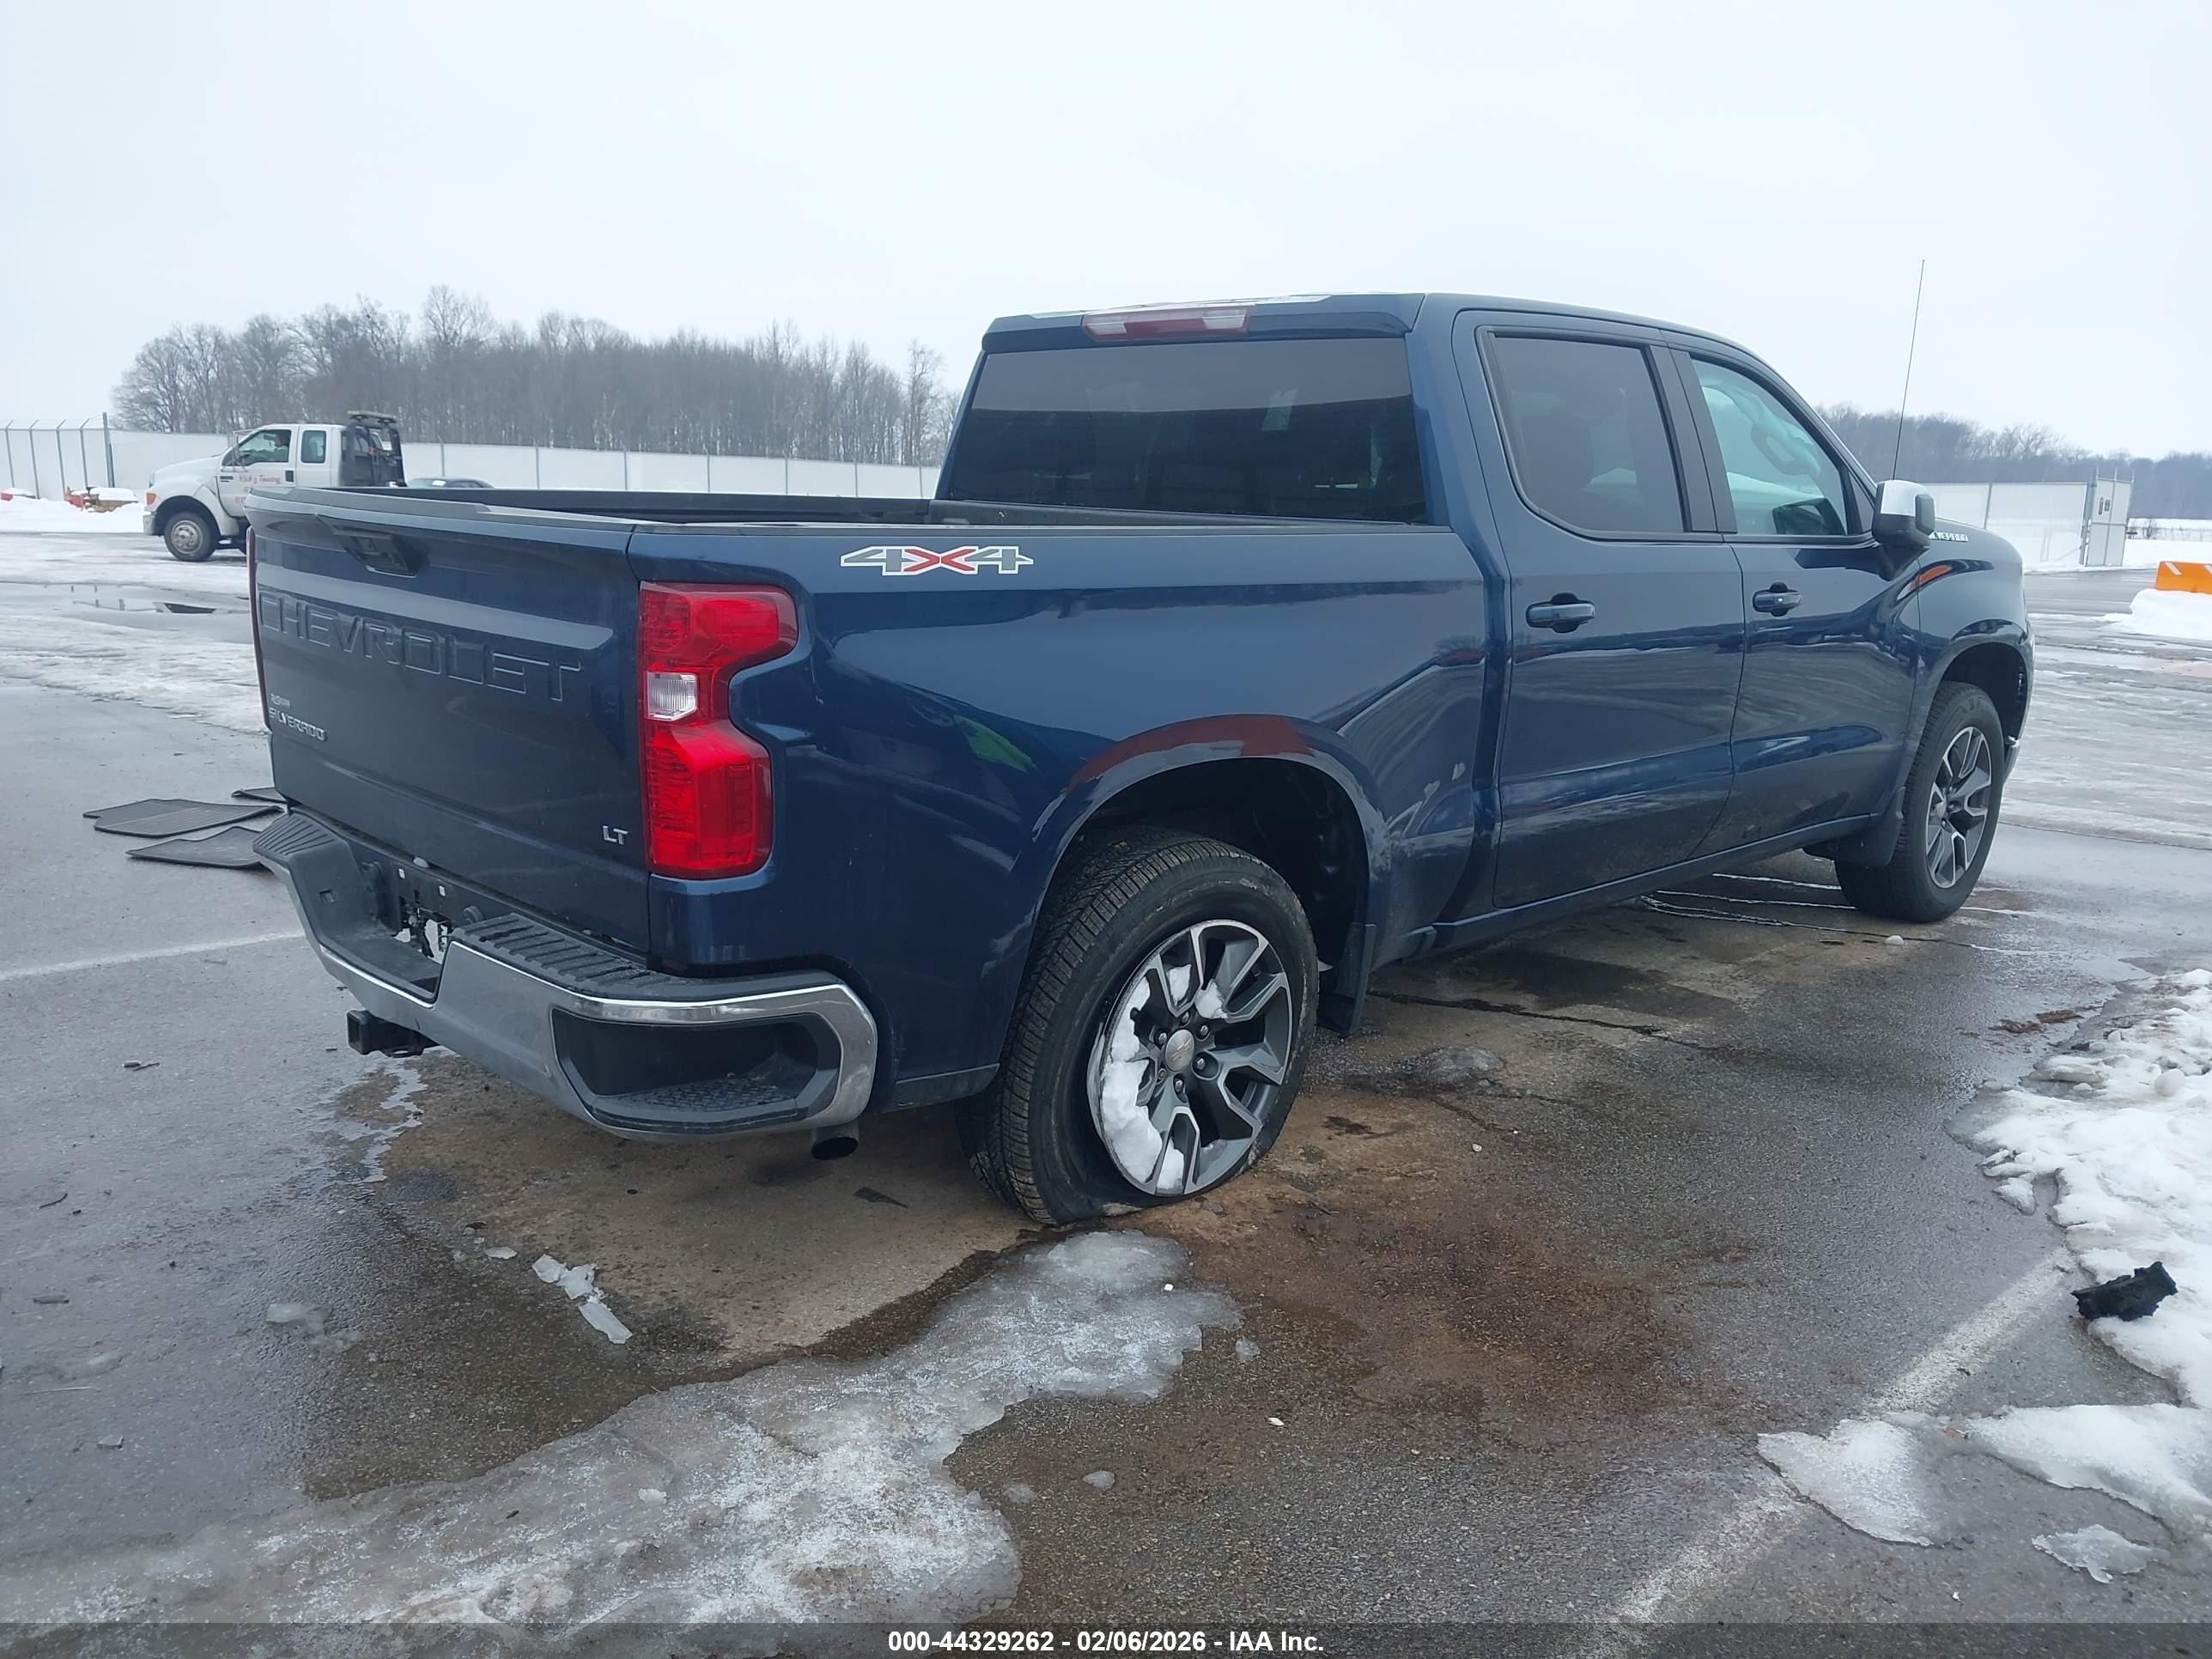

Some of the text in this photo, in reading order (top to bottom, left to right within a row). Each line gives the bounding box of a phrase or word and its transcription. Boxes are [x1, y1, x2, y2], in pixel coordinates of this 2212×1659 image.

[259, 592, 581, 701] CHEVROLET
[269, 708, 325, 741] SILVERADO
[602, 825, 629, 845] LT
